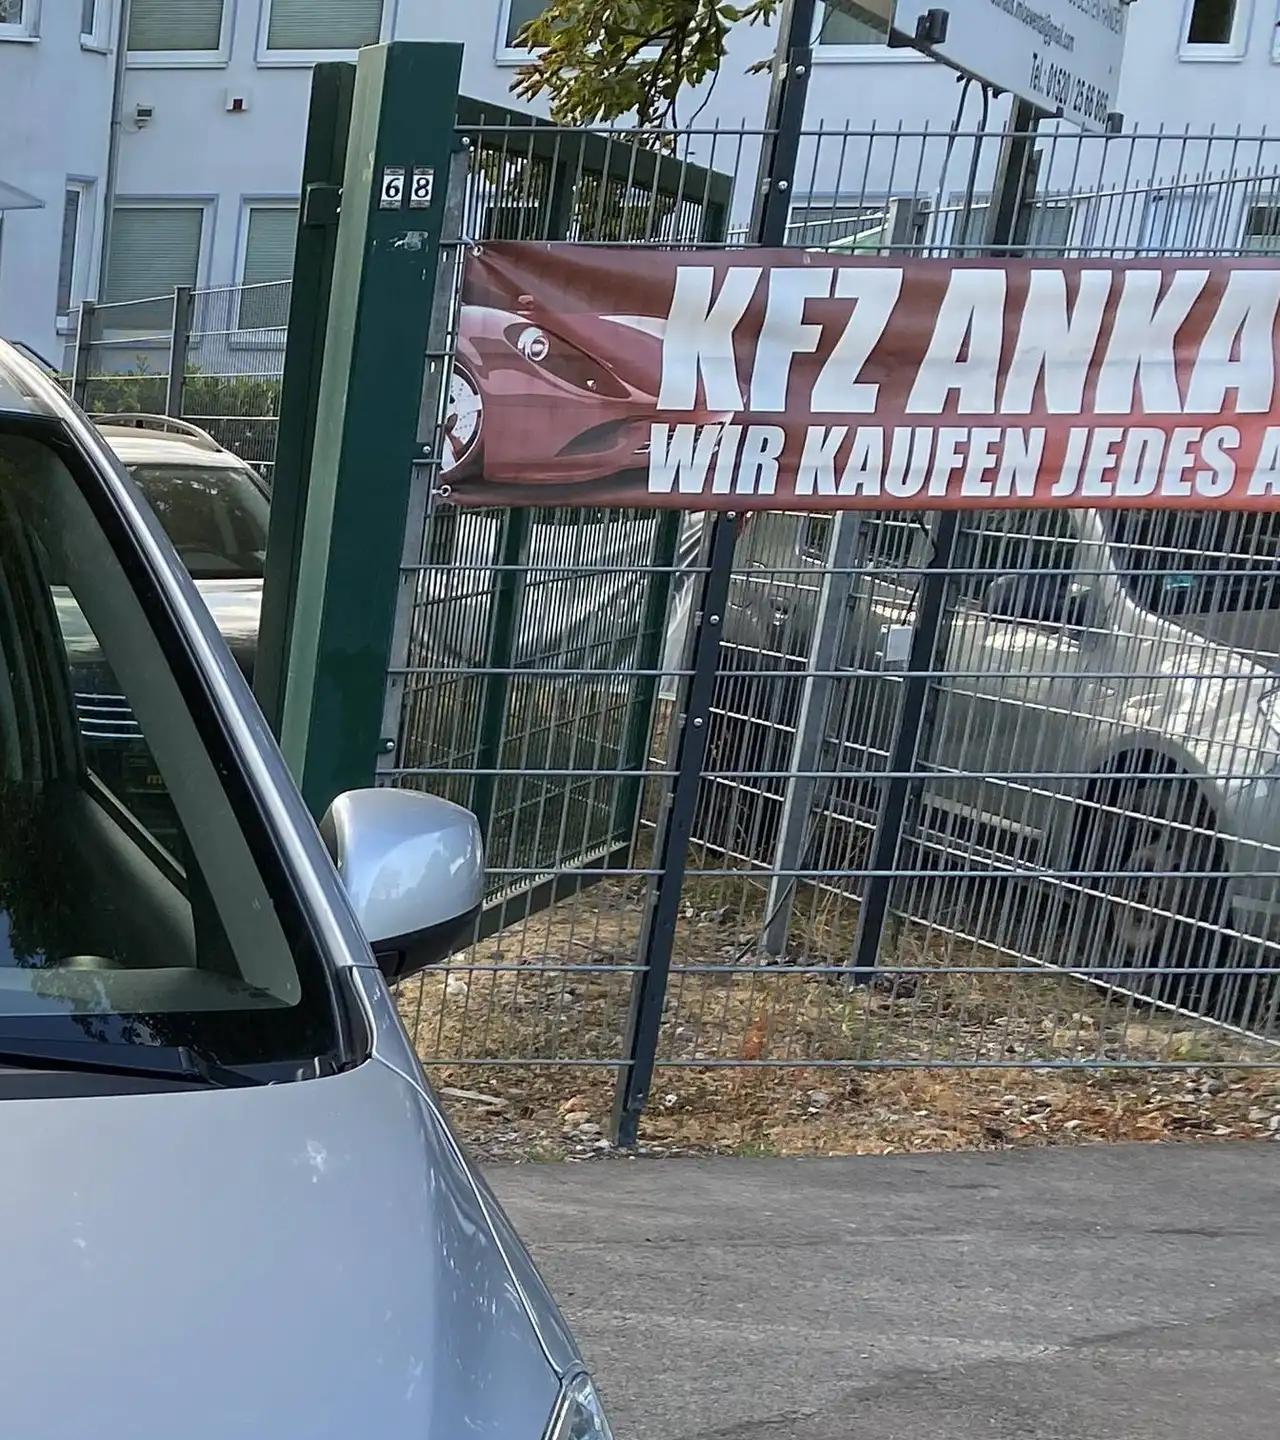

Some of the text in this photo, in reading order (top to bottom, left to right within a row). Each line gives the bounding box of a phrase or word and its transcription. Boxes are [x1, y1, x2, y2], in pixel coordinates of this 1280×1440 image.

[656, 265, 1280, 415] KFZ ANKA
[647, 423, 786, 495] WIR
[794, 424, 1048, 498] KAUFEN
[1051, 425, 1241, 499] JEDES
